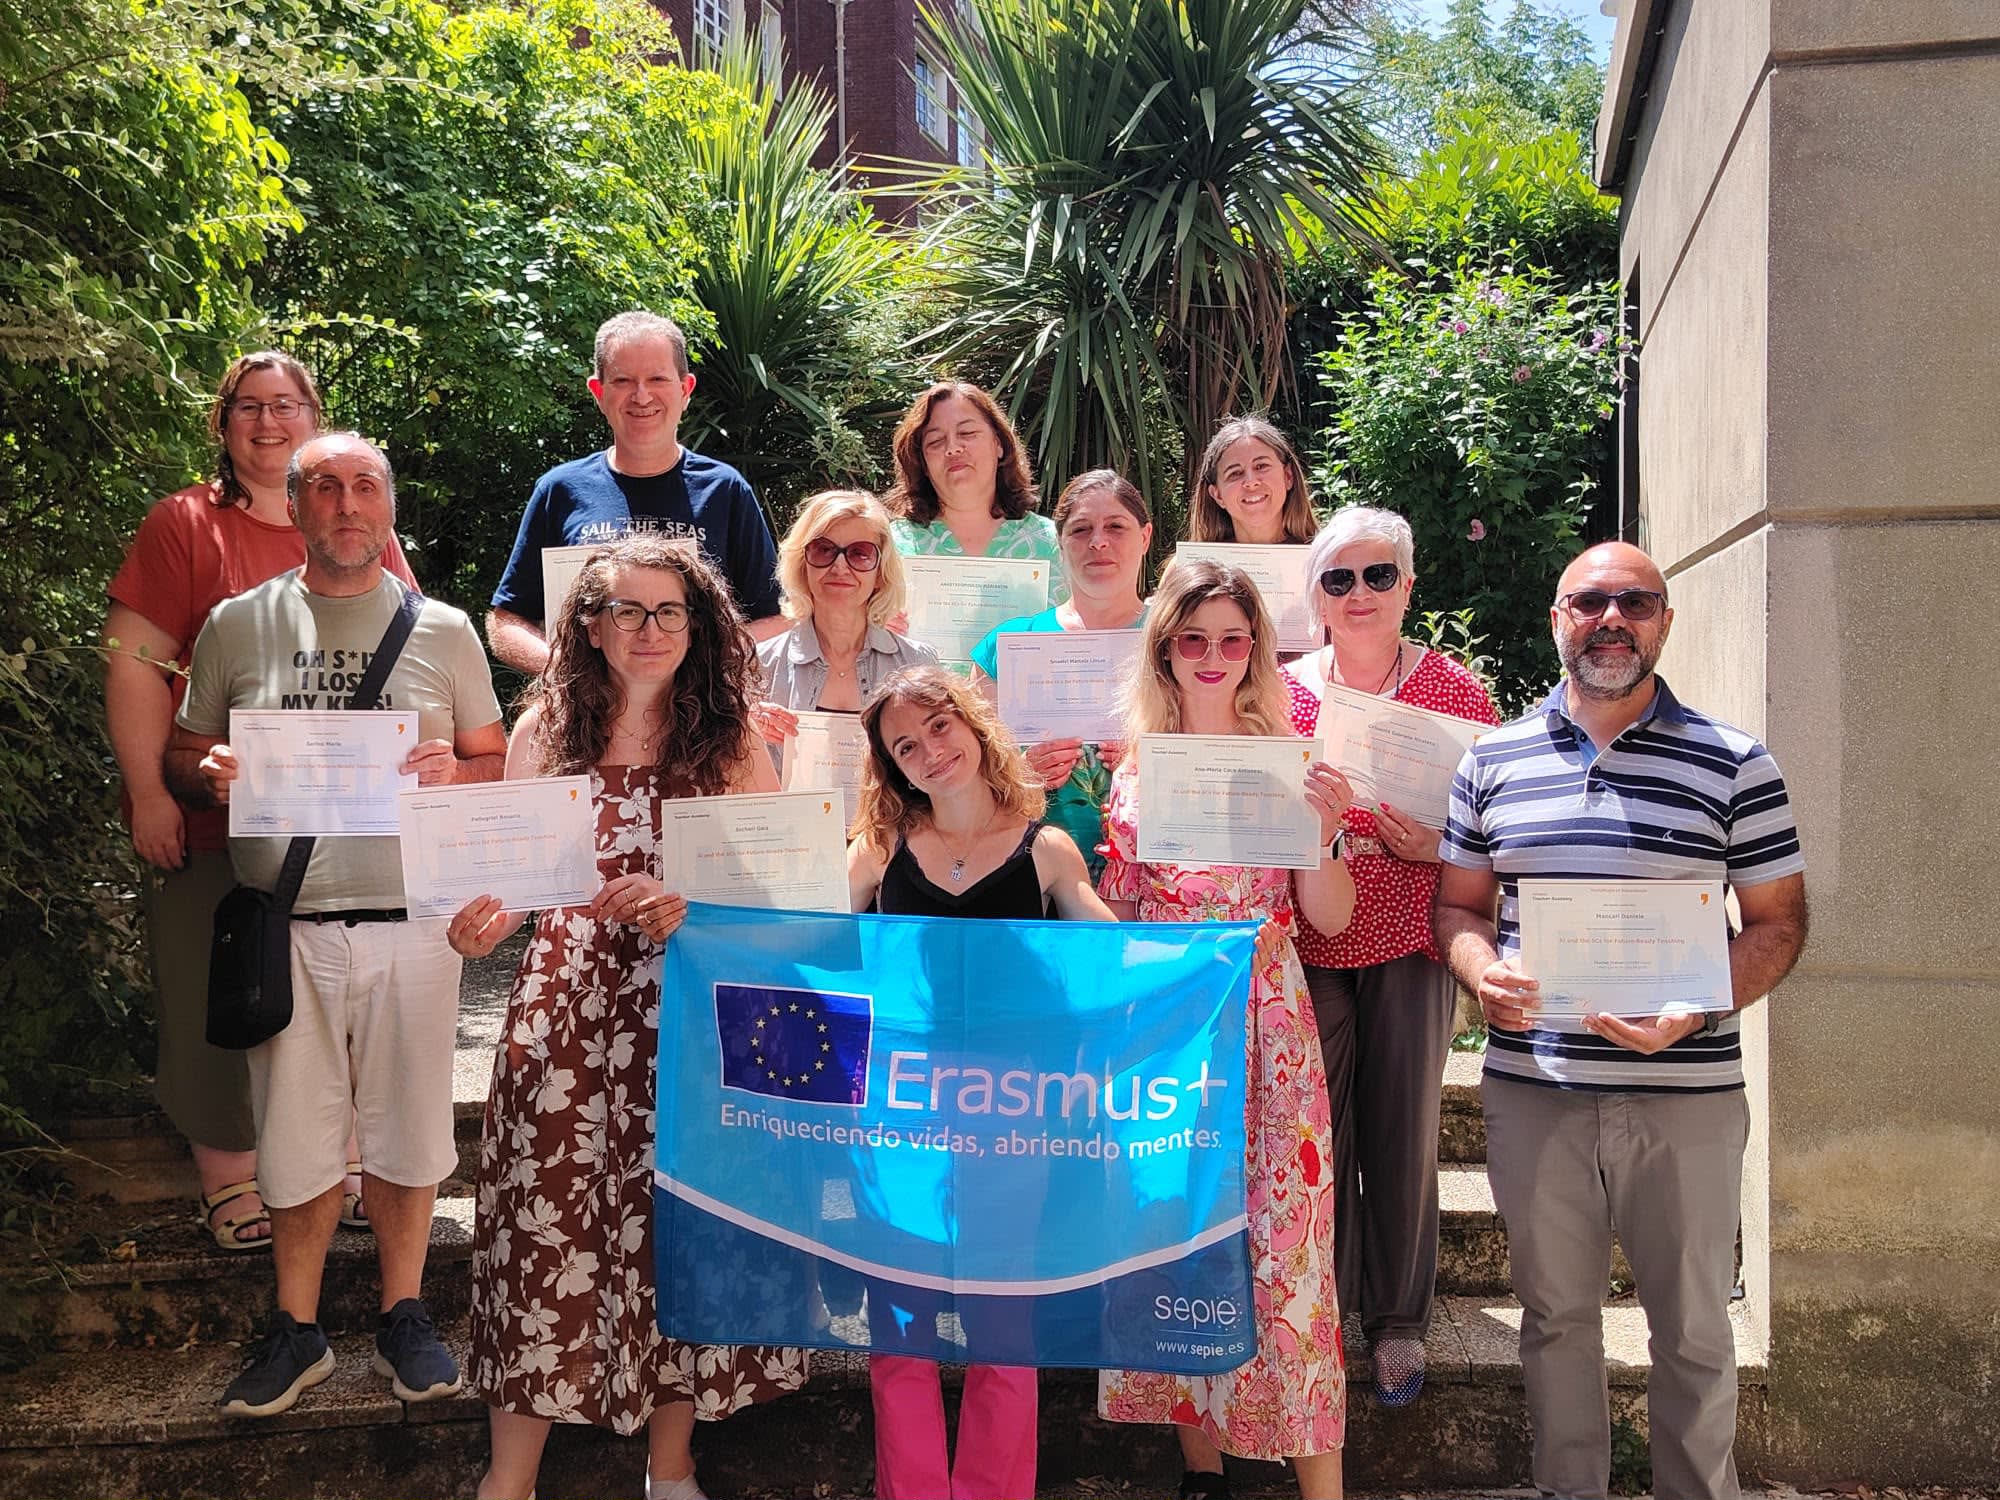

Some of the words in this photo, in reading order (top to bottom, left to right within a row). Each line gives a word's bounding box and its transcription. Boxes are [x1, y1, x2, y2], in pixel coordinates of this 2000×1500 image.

[581, 522, 617, 540] SAIL
[624, 520, 660, 533] THE
[666, 521, 706, 540] SEAS
[293, 650, 325, 669] OH
[333, 650, 377, 669] SI
[301, 672, 309, 690] I
[317, 672, 367, 692] LOS
[281, 694, 318, 710] MY
[887, 1051, 1228, 1121] Erasmus+
[720, 1103, 900, 1149] Enriqueciendo
[908, 1125, 984, 1157] vidas,
[995, 1129, 1120, 1160] abriendo
[1154, 1295, 1237, 1330] sepie
[1155, 1341, 1245, 1359] www.sepie.es
